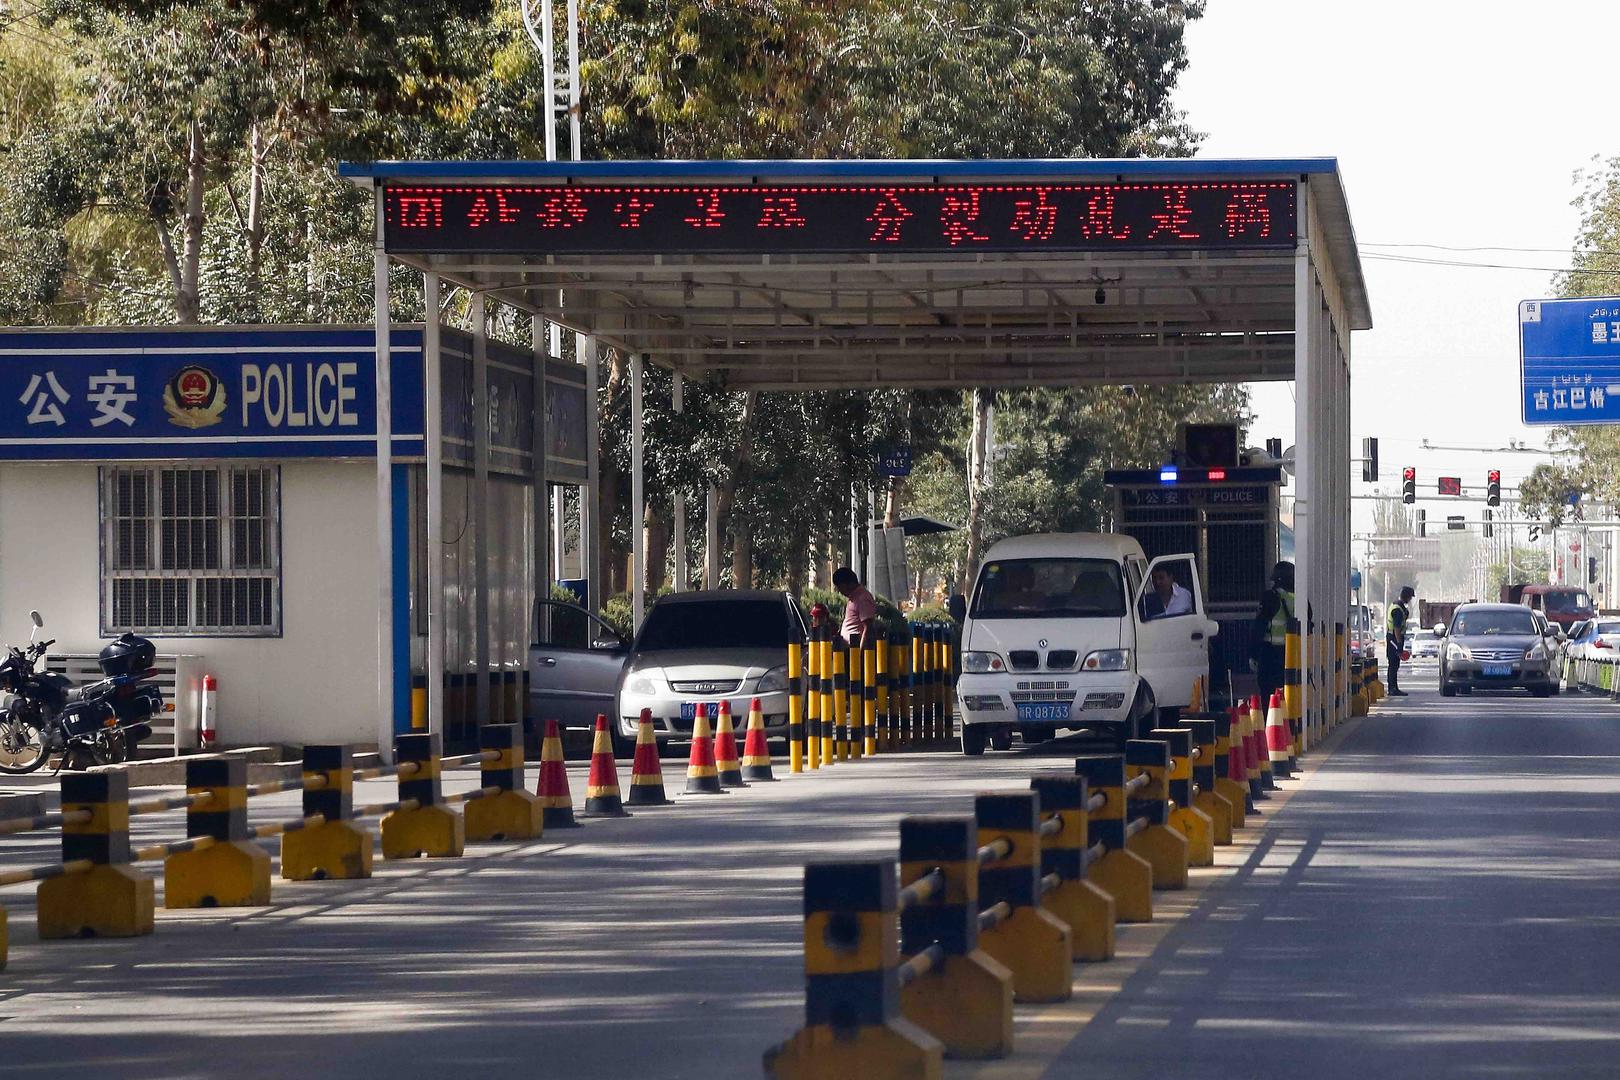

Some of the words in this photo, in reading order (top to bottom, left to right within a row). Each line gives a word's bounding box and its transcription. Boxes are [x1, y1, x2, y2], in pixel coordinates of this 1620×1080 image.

[19, 368, 138, 427] 公安
[241, 362, 359, 427] POLICE
[1533, 386, 1605, 411] 古江巴格
[1145, 491, 1179, 504] 公安
[1213, 491, 1254, 503] POLICE
